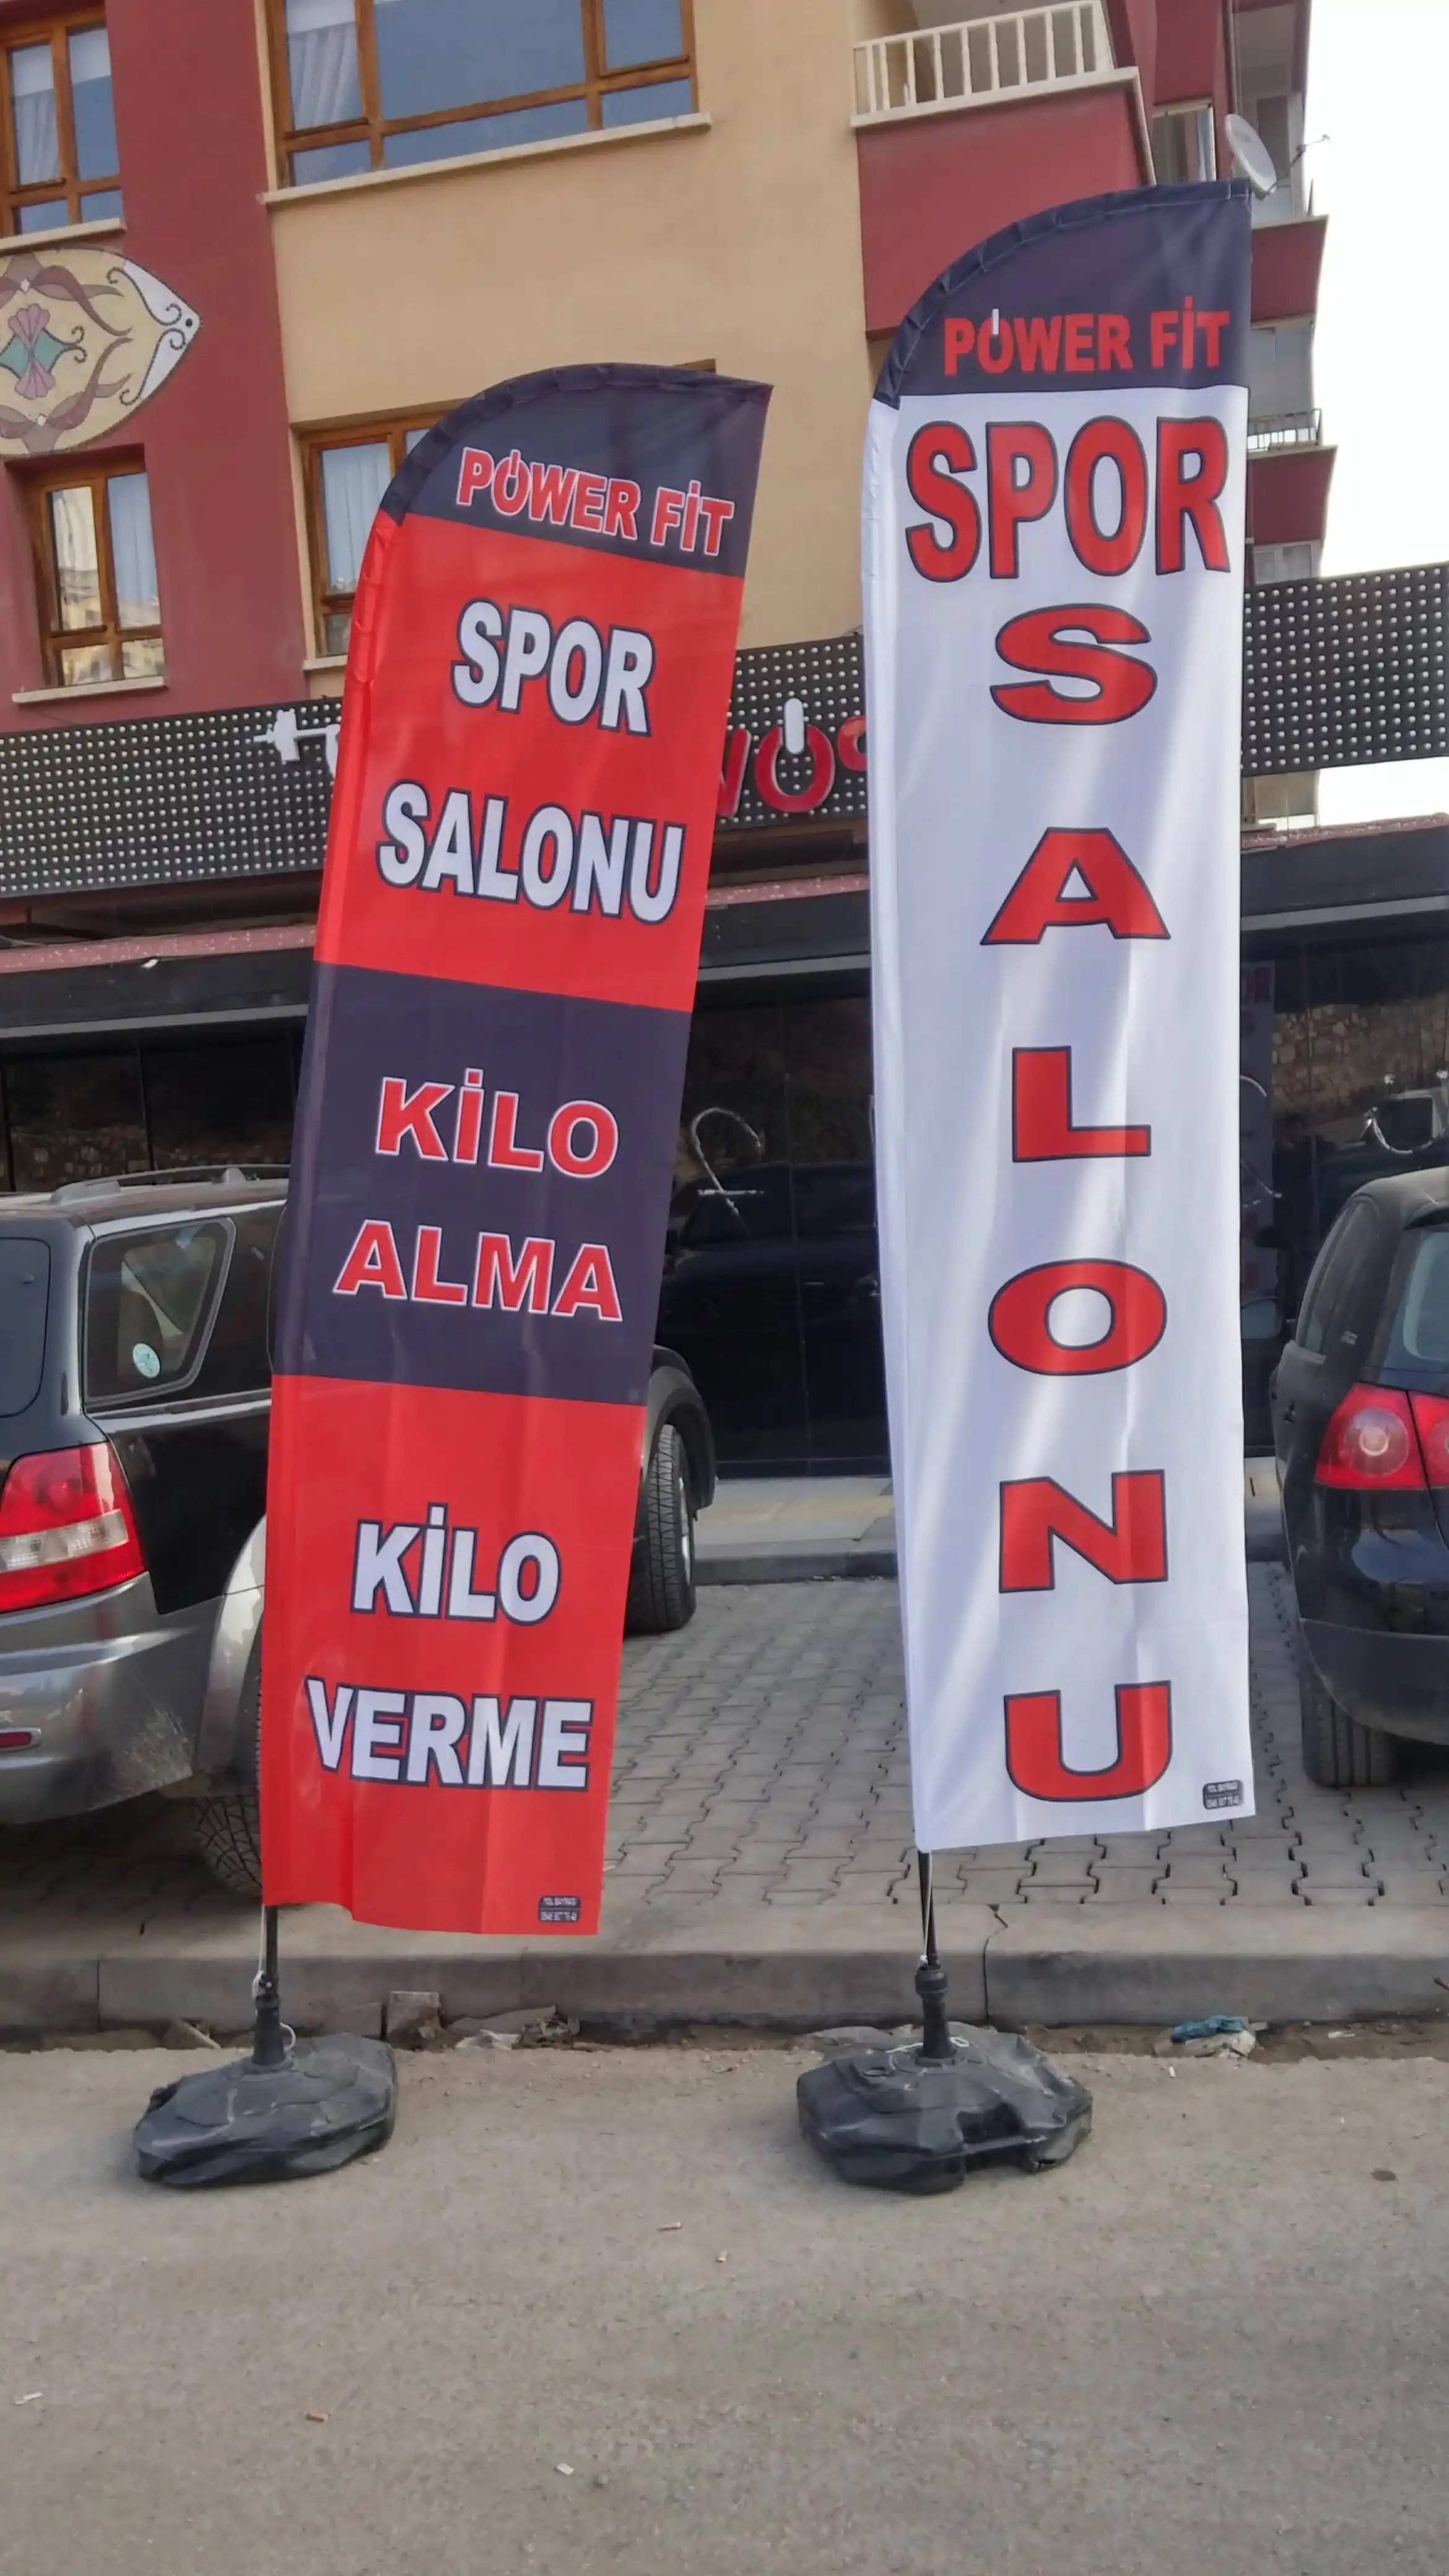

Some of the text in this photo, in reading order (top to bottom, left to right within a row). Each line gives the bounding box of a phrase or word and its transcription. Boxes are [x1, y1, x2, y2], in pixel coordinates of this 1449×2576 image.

[944, 295, 1229, 376] POWER FİT
[456, 447, 735, 556] POWER FİT
[905, 415, 1231, 583] SPOR
[451, 596, 656, 737] SPOR
[376, 778, 687, 925] SALONU
[375, 1068, 619, 1178] KİLO
[332, 1219, 623, 1321] ALMA
[350, 1502, 562, 1626] KİLO
[303, 1675, 596, 1792] VERME
